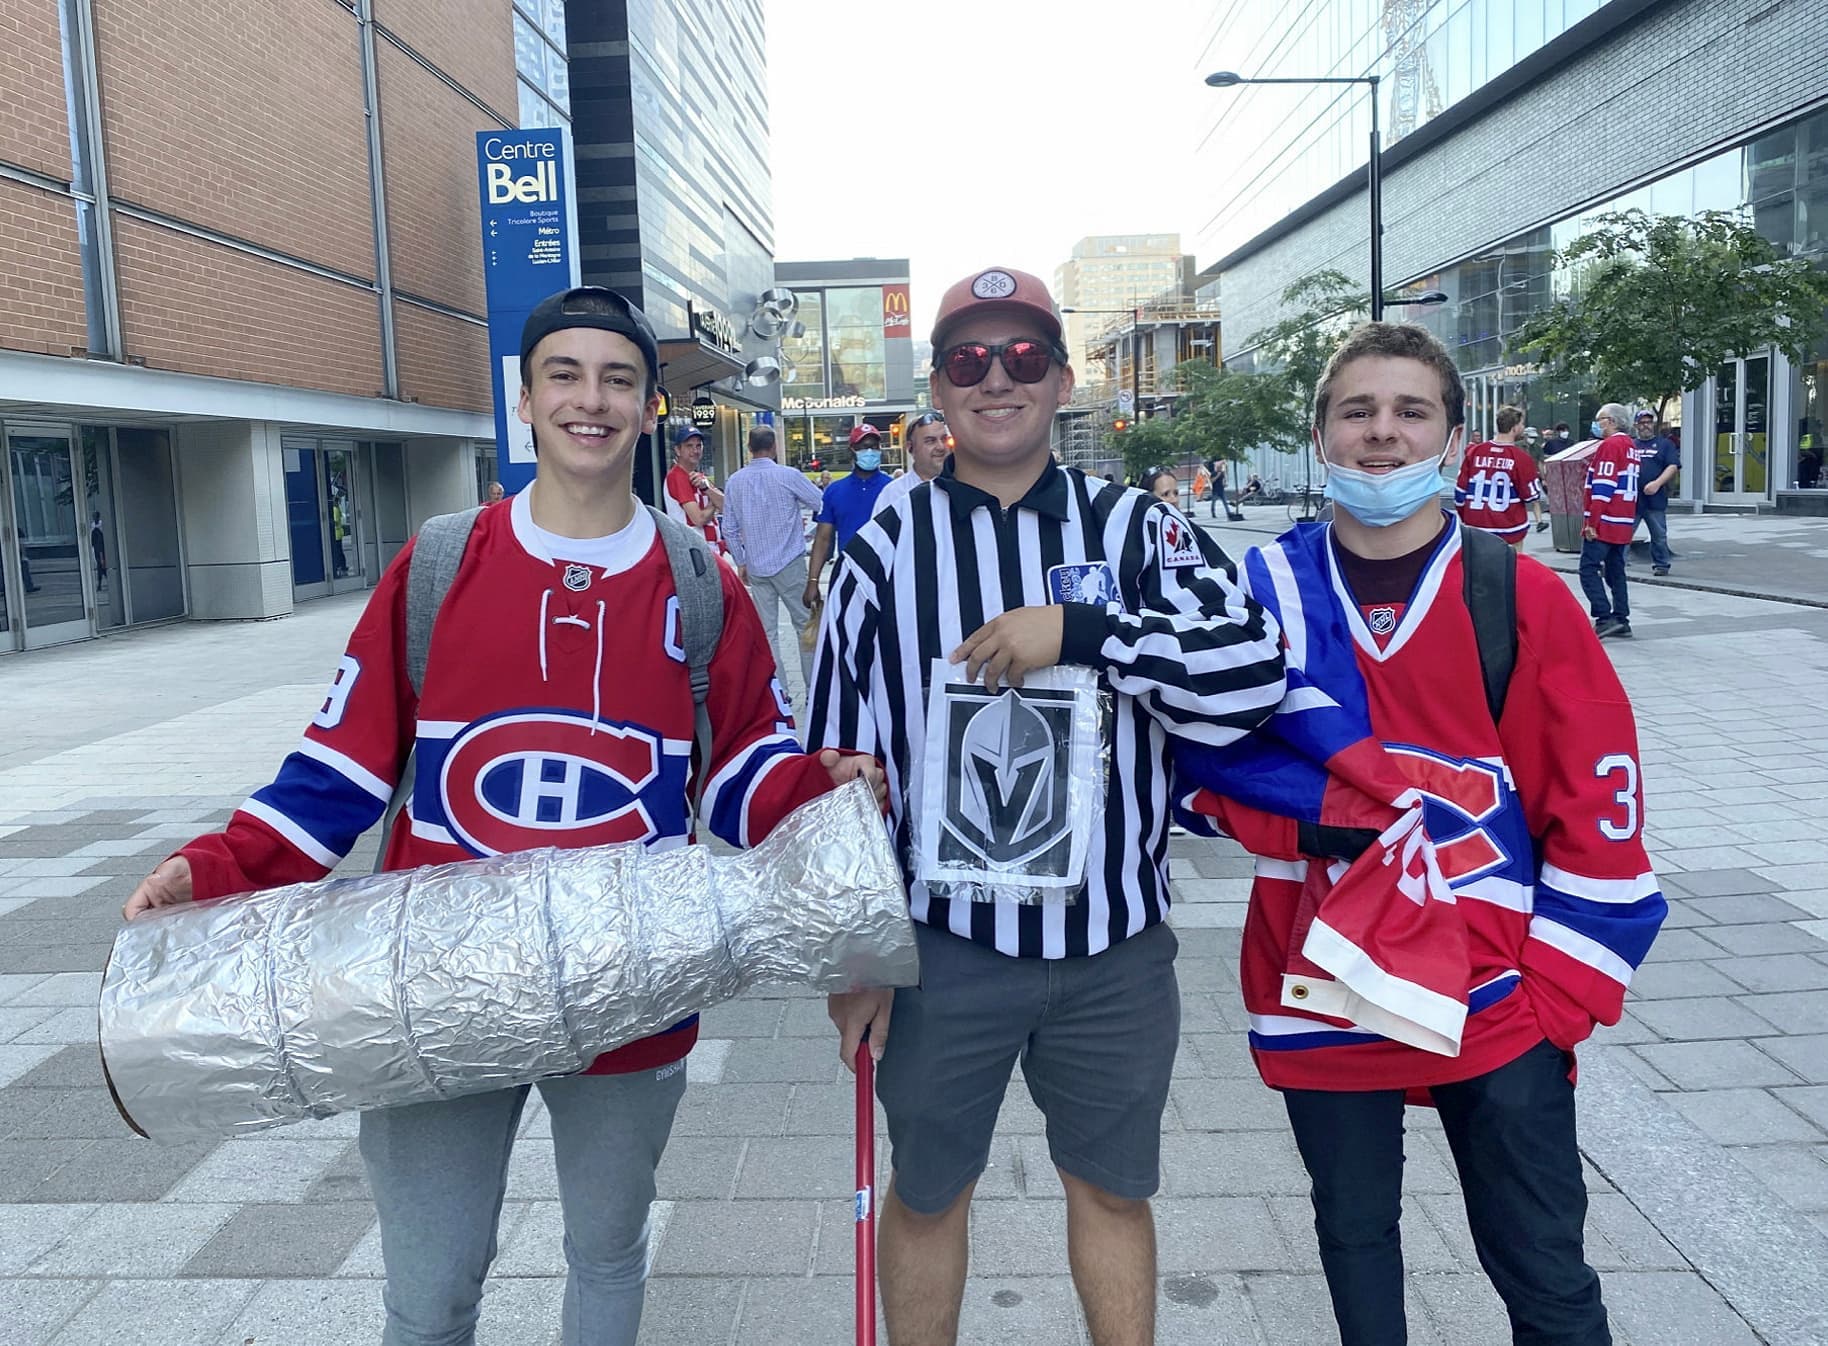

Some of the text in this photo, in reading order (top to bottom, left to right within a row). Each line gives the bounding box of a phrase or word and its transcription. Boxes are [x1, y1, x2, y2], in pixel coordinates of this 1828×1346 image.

[484, 137, 556, 160] Centre
[486, 160, 558, 204] Bell
[529, 210, 559, 218] Boutique
[538, 227, 560, 236] Métro
[534, 240, 560, 248] Entrées
[780, 395, 866, 410] McDonald's
[1597, 461, 1615, 477] 10
[1469, 469, 1511, 512] 10
[1167, 555, 1200, 563] CANADA
[1594, 752, 1639, 842] 3
